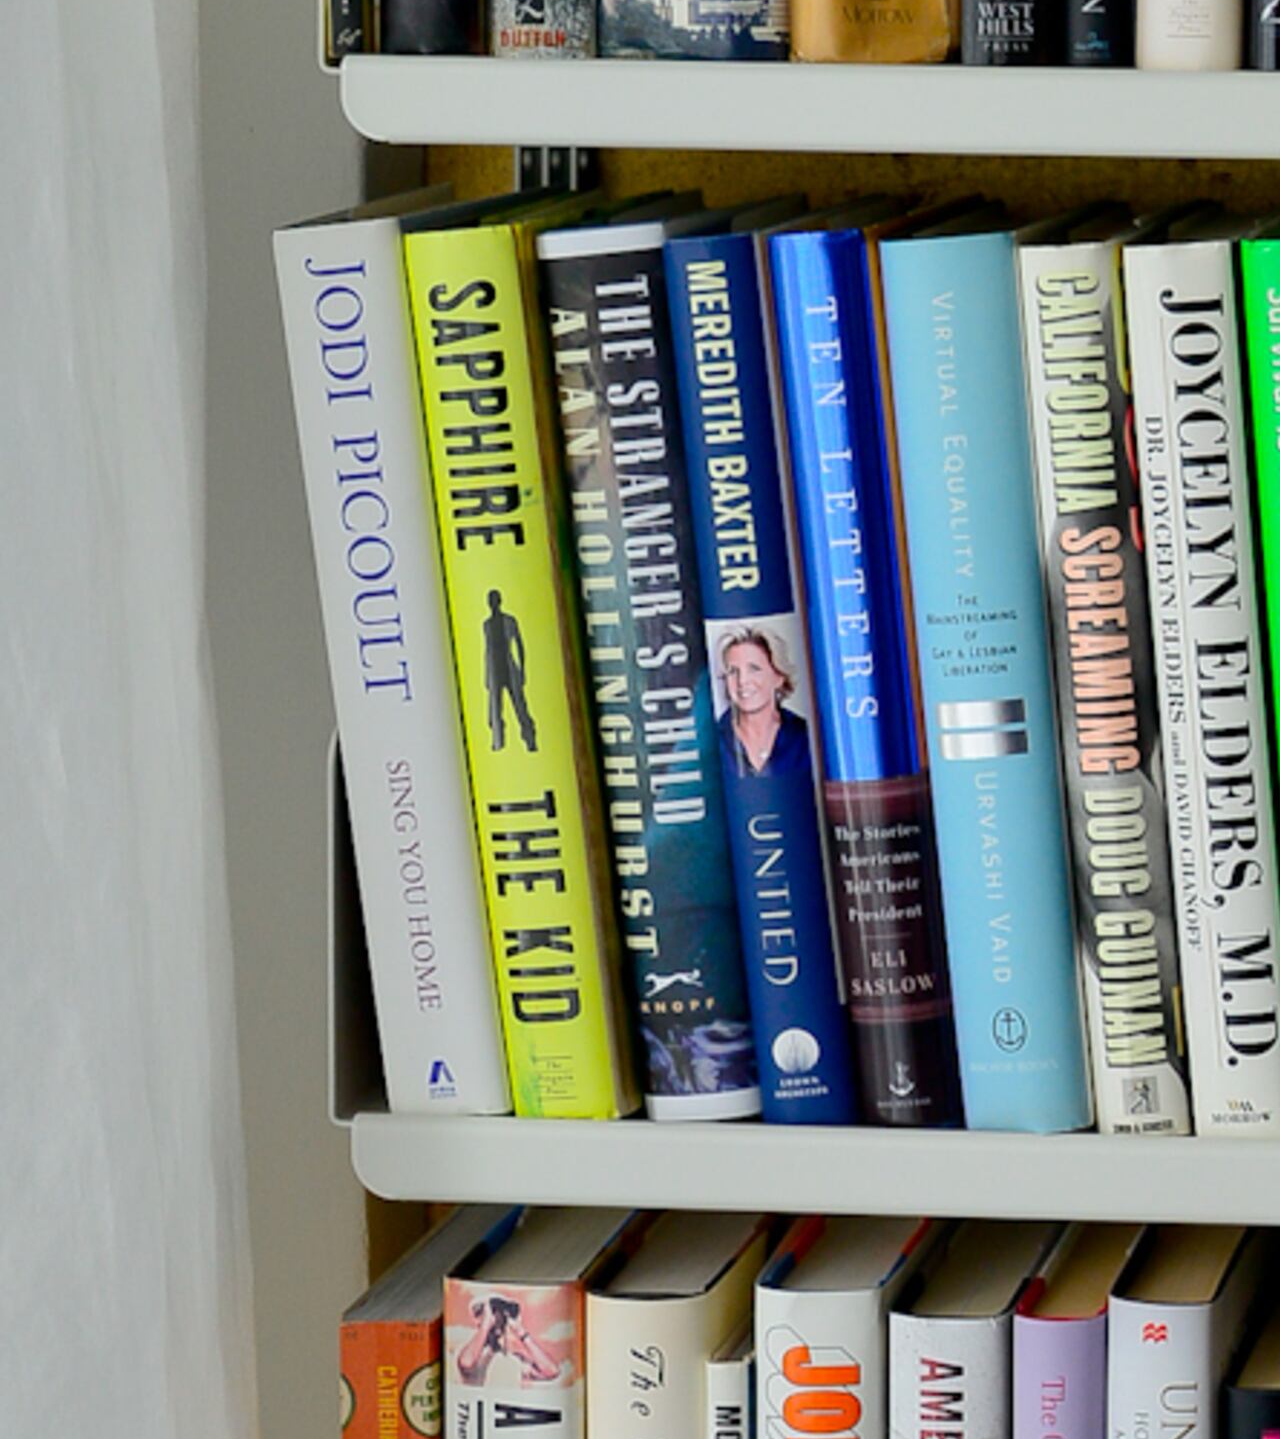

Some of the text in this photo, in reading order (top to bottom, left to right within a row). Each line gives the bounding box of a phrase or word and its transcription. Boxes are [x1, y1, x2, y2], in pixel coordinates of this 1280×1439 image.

[304, 260, 413, 702] JODI PICOULT
[427, 280, 529, 552] SAPPHIRE
[687, 261, 760, 592] MEREDITH BAXTER
[487, 789, 583, 1025] THE KID
[746, 813, 799, 986] UNTIED
[493, 1401, 564, 1429] A
